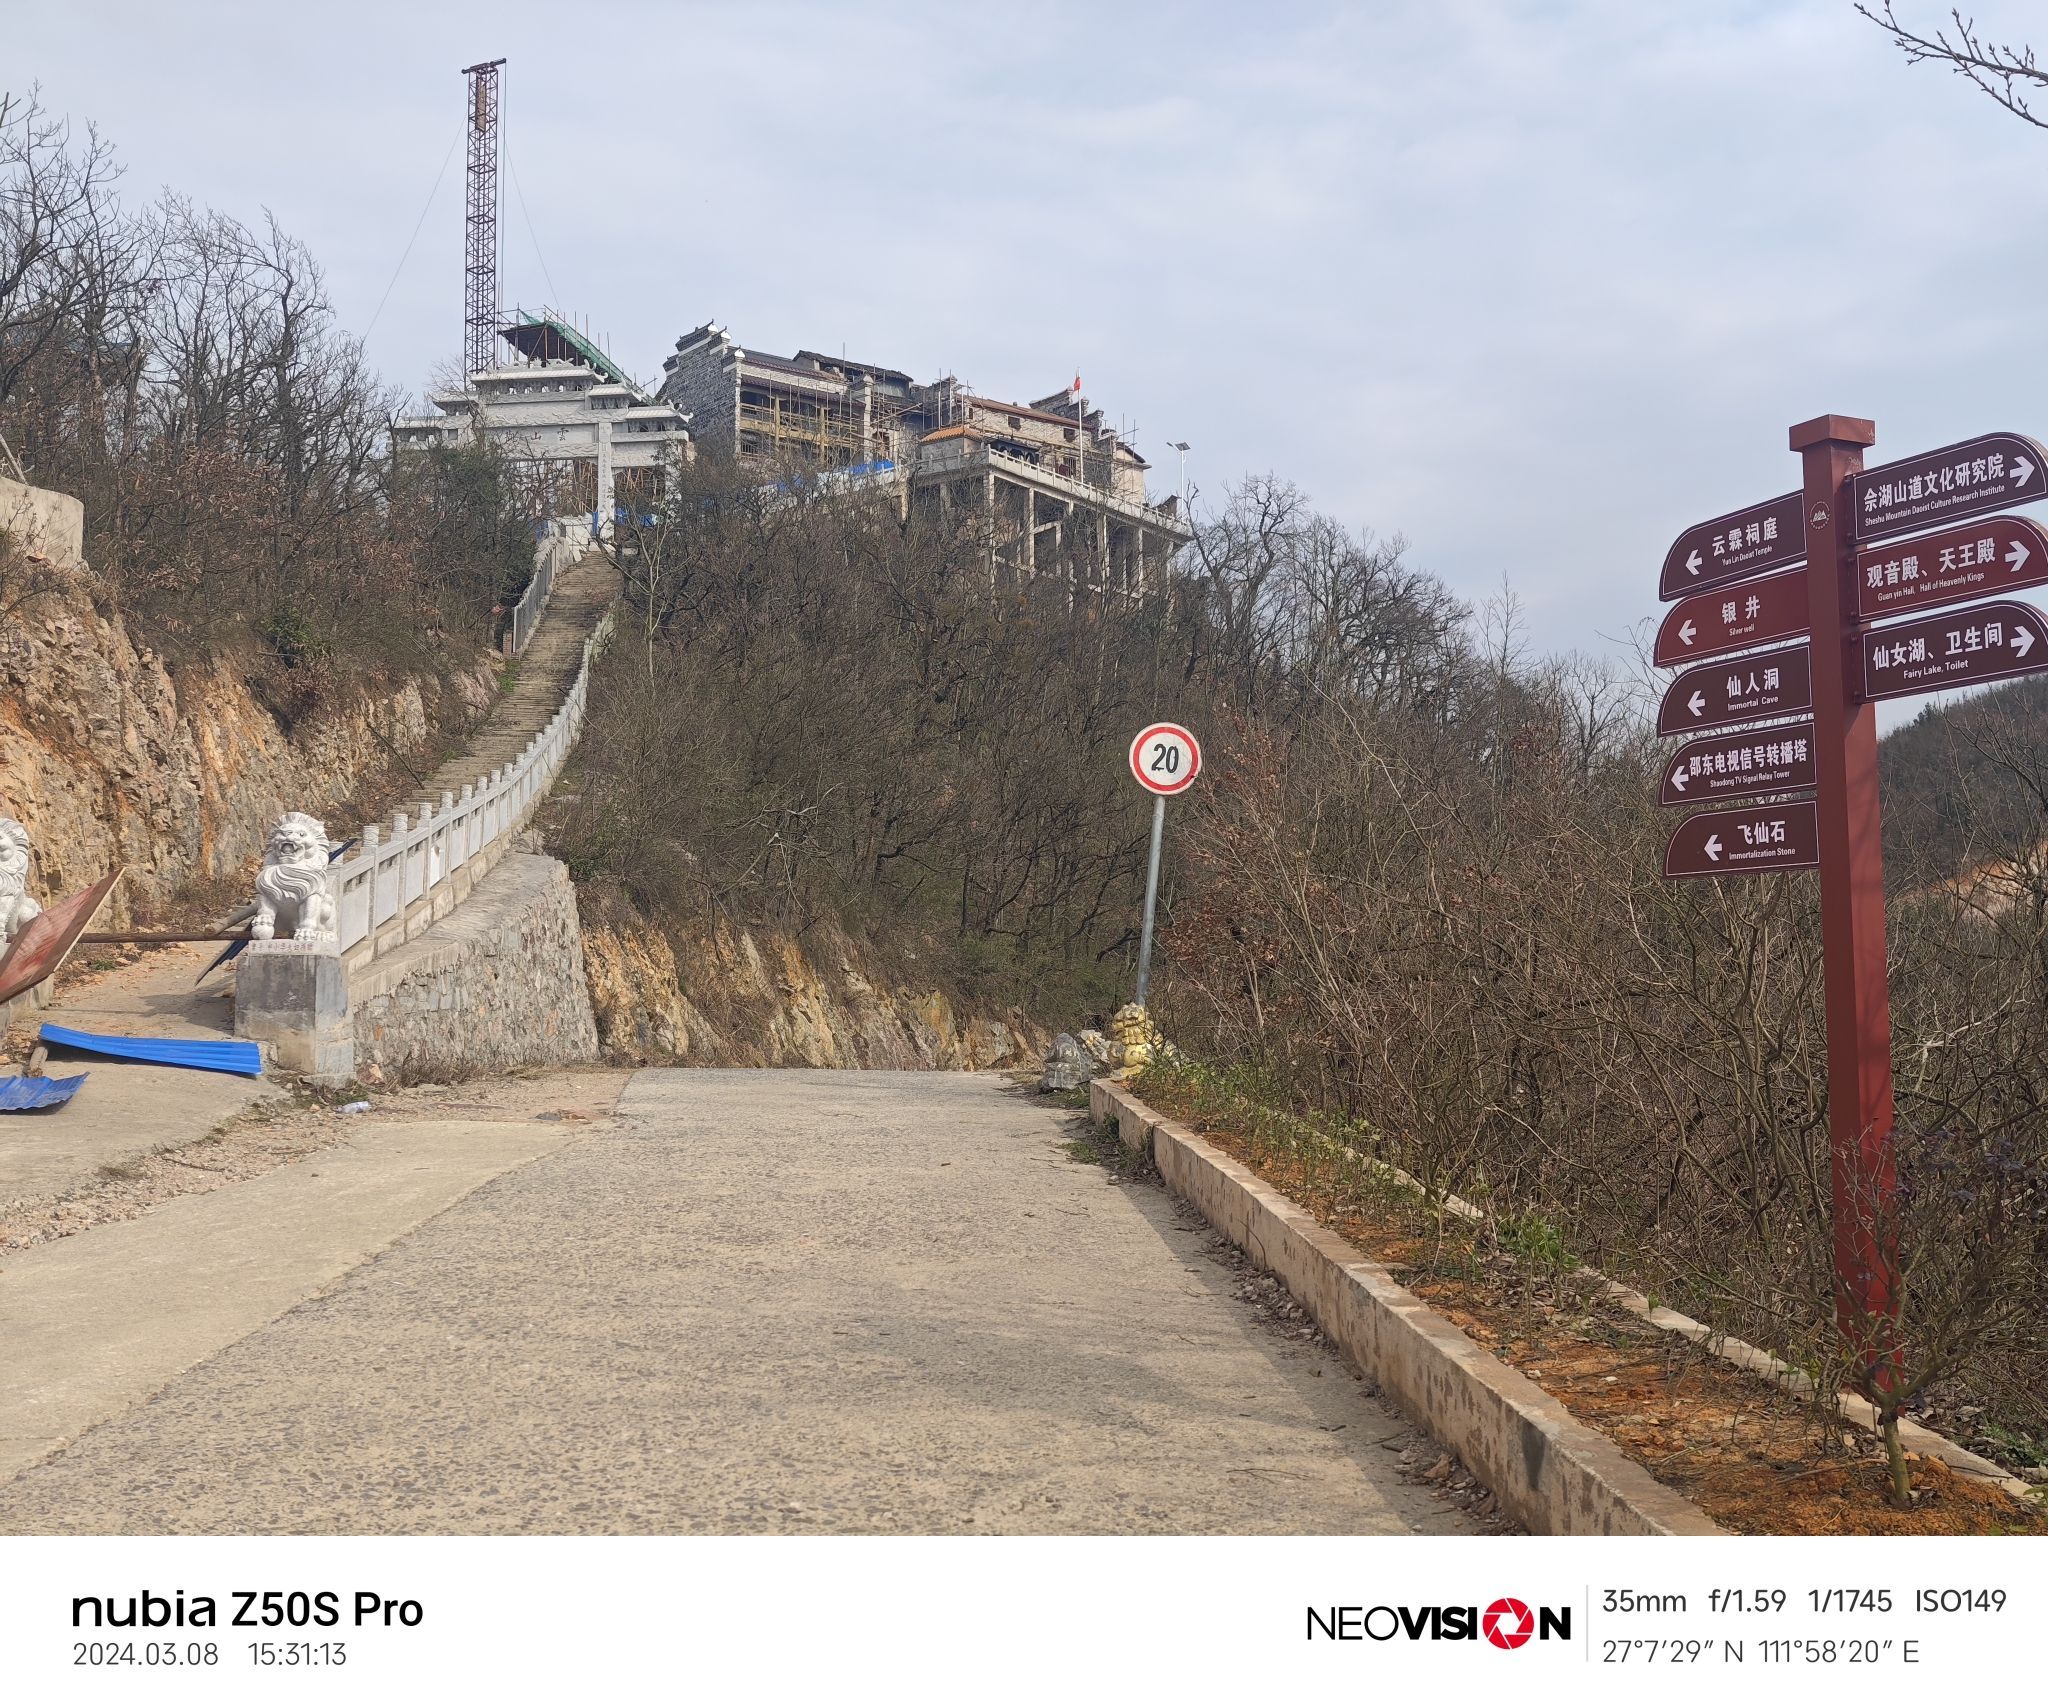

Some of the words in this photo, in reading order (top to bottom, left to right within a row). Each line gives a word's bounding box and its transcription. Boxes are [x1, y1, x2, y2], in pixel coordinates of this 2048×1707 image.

[1864, 453, 2004, 512] 佘湖山道文化研究院
[1886, 507, 1911, 522] Mountain
[1912, 502, 1930, 514] Daoist
[1931, 498, 1951, 510] Culture
[1952, 491, 1979, 504] Research
[1980, 484, 2005, 498] Institute
[1712, 517, 1778, 557] 云霖祠庭
[1755, 545, 1772, 556] Temple
[1867, 537, 1995, 589] 观音殿、天王殿
[1878, 592, 1892, 601] Guan
[1894, 590, 1902, 599] yin
[1920, 582, 1931, 591] Hall
[1932, 580, 1938, 589] of
[1939, 574, 1966, 588] Heavenly
[1967, 572, 1984, 582] Kings
[1873, 622, 2003, 670] 仙女湖、卫生间
[1727, 668, 1779, 699] 仙人洞
[1904, 669, 1922, 679] Fairy
[1924, 665, 1943, 675] Lake,
[1945, 659, 1968, 670] Toilet
[1728, 698, 1758, 711] Immortal
[1762, 696, 1778, 704] Cave
[1152, 744, 1179, 773] 20
[1689, 739, 1807, 777] 邵东电视信号转播塔
[1710, 778, 1734, 788] Shaodong
[1735, 776, 1742, 784] TV
[1743, 774, 1758, 784] Signal
[1759, 773, 1773, 781] Relay
[1737, 821, 1786, 845] 飞仙石
[1729, 849, 1776, 860] Immortalization
[1777, 848, 1795, 856] Stone
